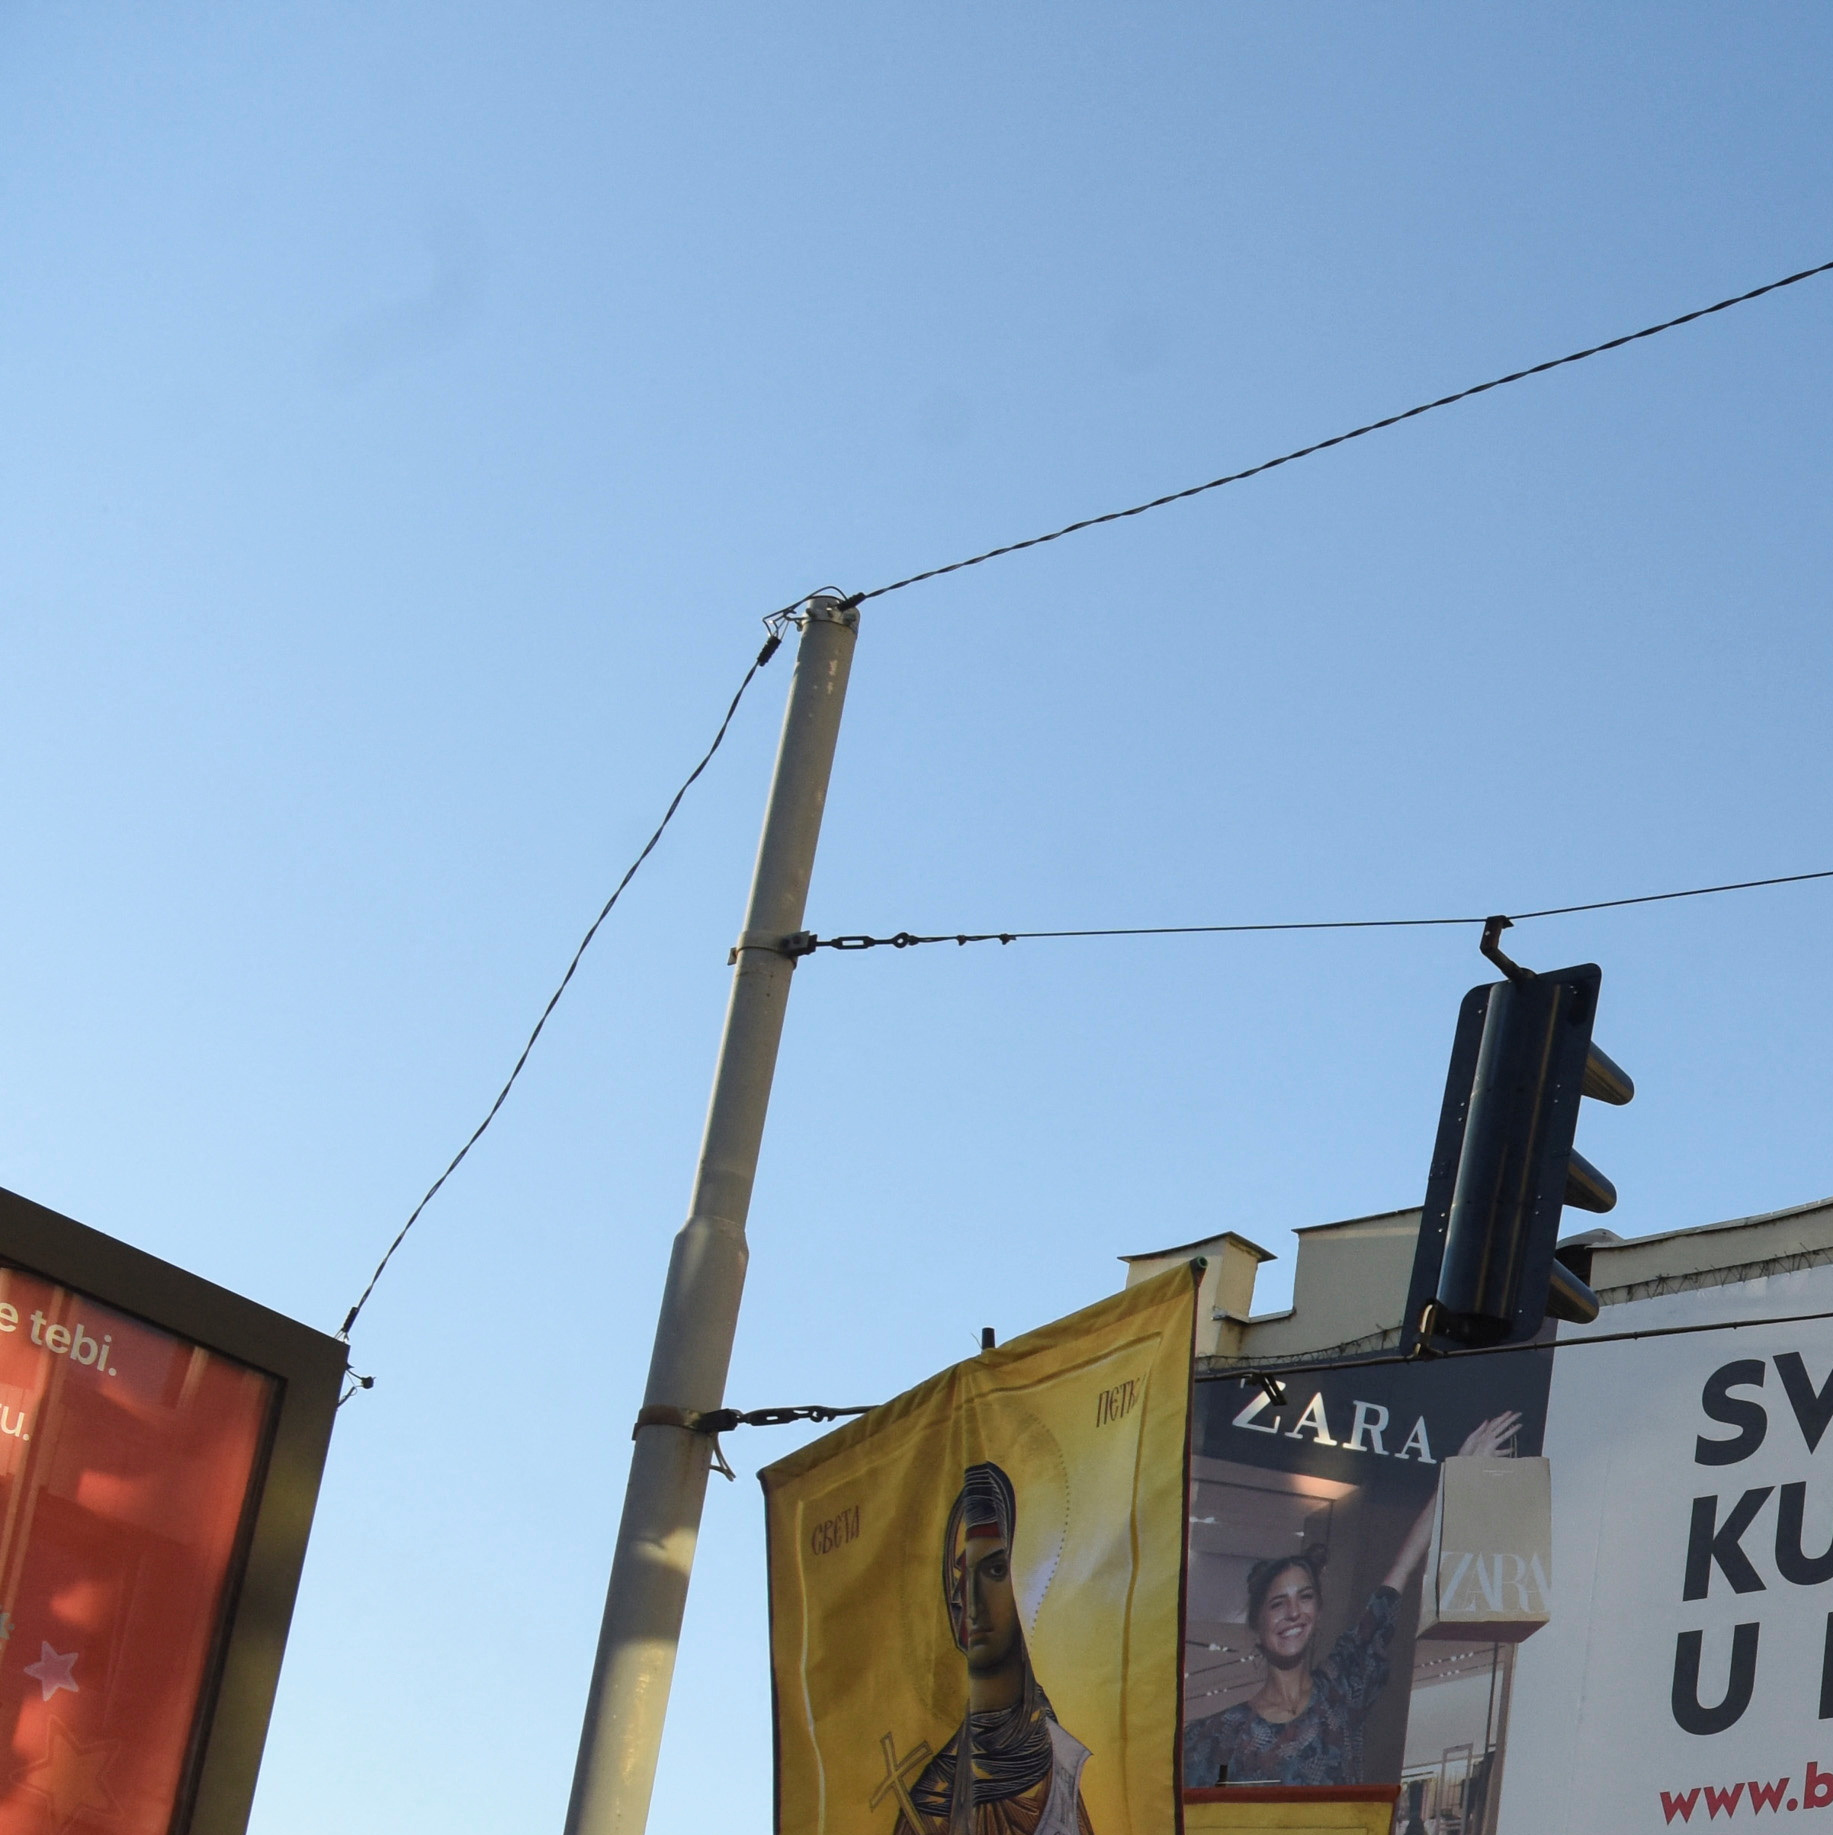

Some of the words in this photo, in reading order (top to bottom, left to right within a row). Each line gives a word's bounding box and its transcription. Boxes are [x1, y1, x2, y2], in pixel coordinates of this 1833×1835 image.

[30, 1310, 117, 1376] tebi.
[1096, 1377, 1140, 1427] ПЕТК
[1232, 1377, 1437, 1464] ZARA
[1440, 1552, 1553, 1614] ZARA
[1670, 1621, 1759, 1735] U
